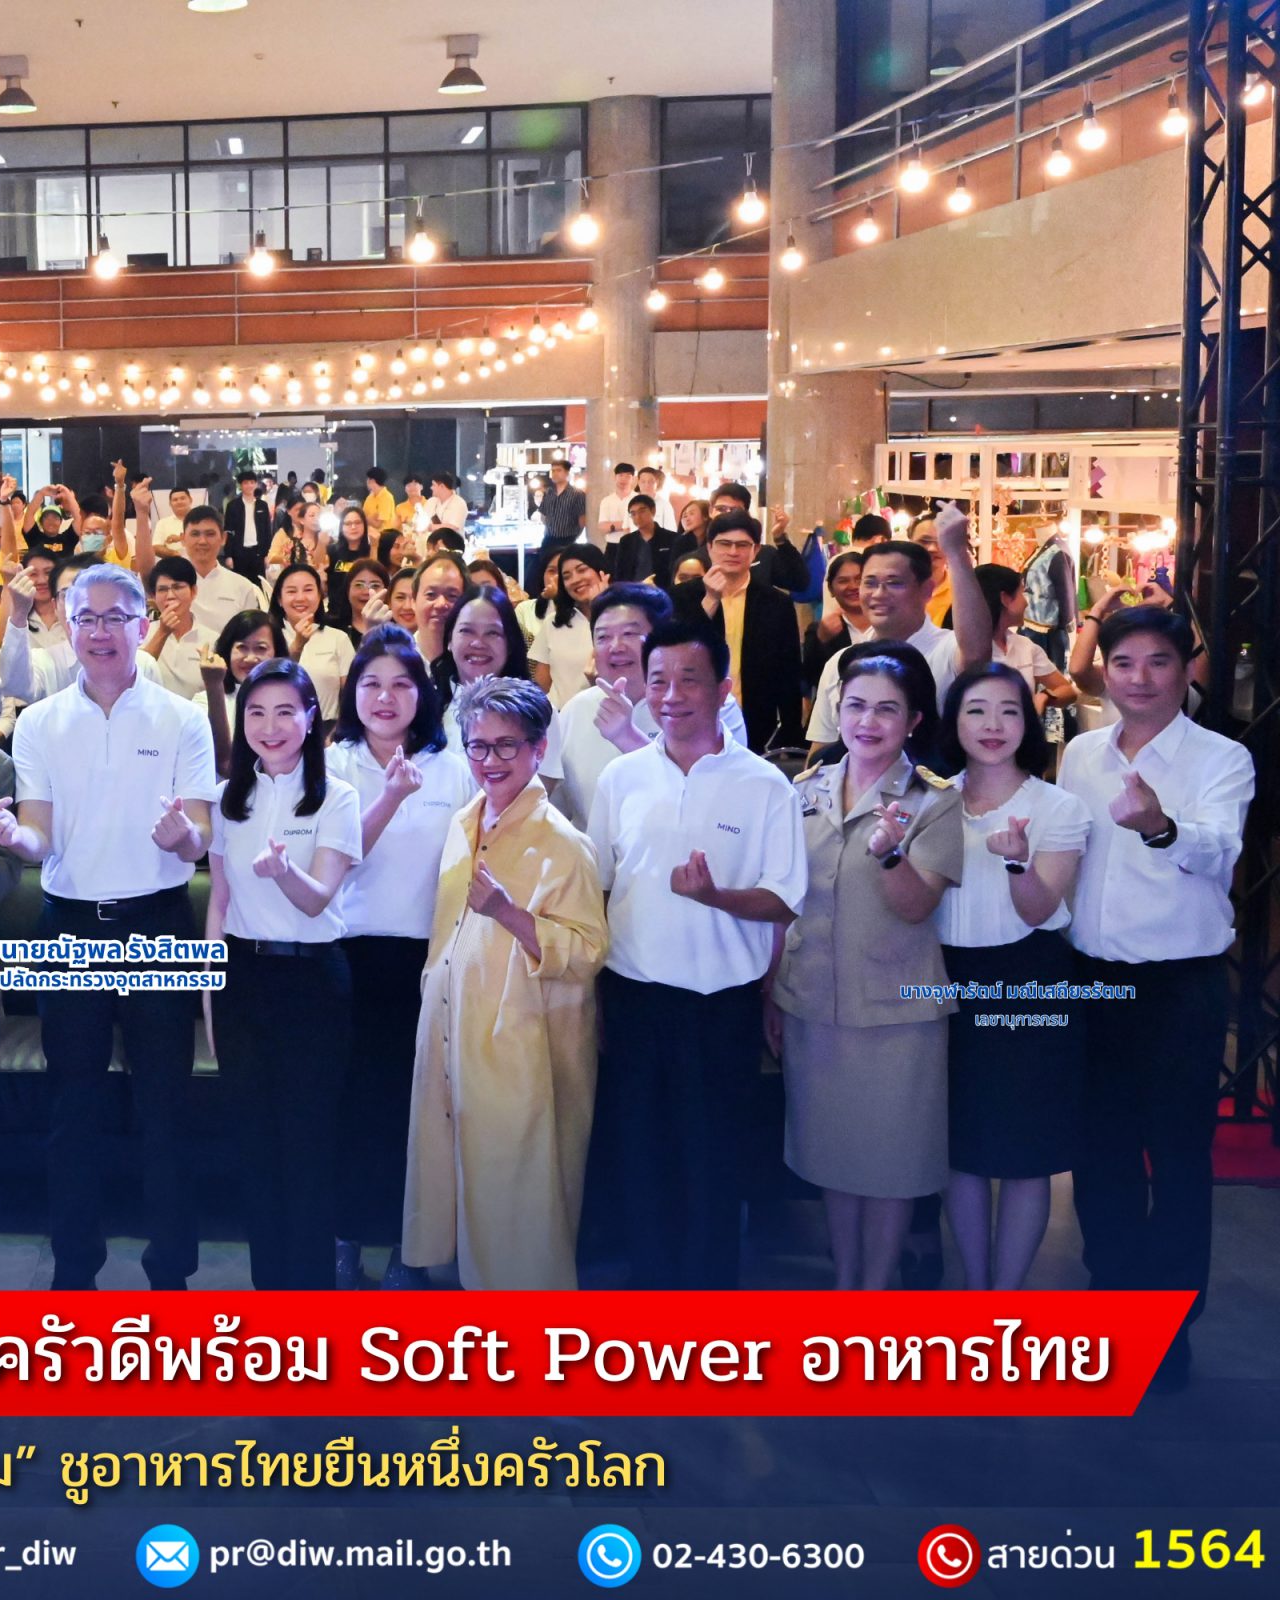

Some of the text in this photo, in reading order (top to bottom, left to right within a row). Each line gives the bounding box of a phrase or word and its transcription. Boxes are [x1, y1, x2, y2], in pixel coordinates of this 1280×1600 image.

[137, 748, 159, 757] MIND
[283, 828, 313, 837] DIPROM
[716, 822, 741, 835] MIND
